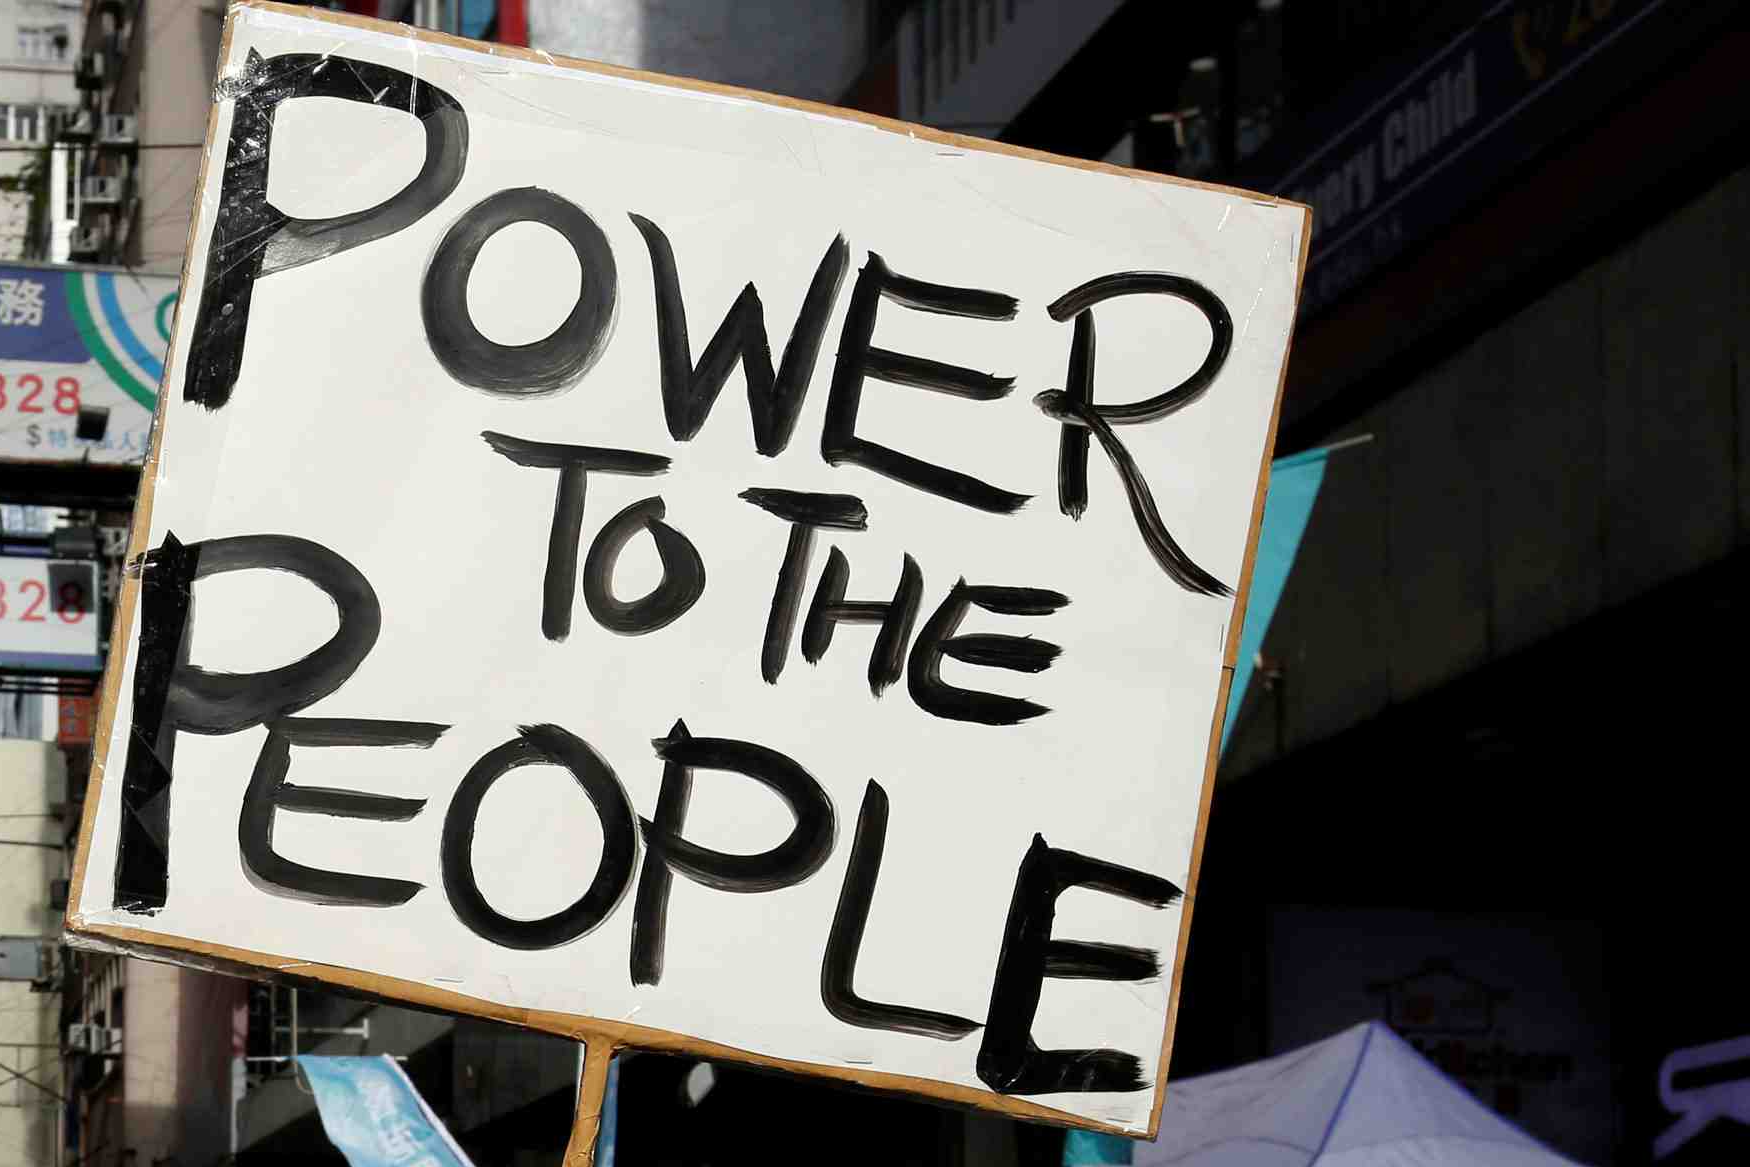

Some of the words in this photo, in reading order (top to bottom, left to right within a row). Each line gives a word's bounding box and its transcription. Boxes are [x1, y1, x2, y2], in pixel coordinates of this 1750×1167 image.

[182, 46, 1235, 598] POWER
[1383, 47, 1478, 182] Child
[481, 430, 708, 643] TO
[738, 485, 1071, 727] THE
[113, 530, 1185, 1096] PEOPLE
